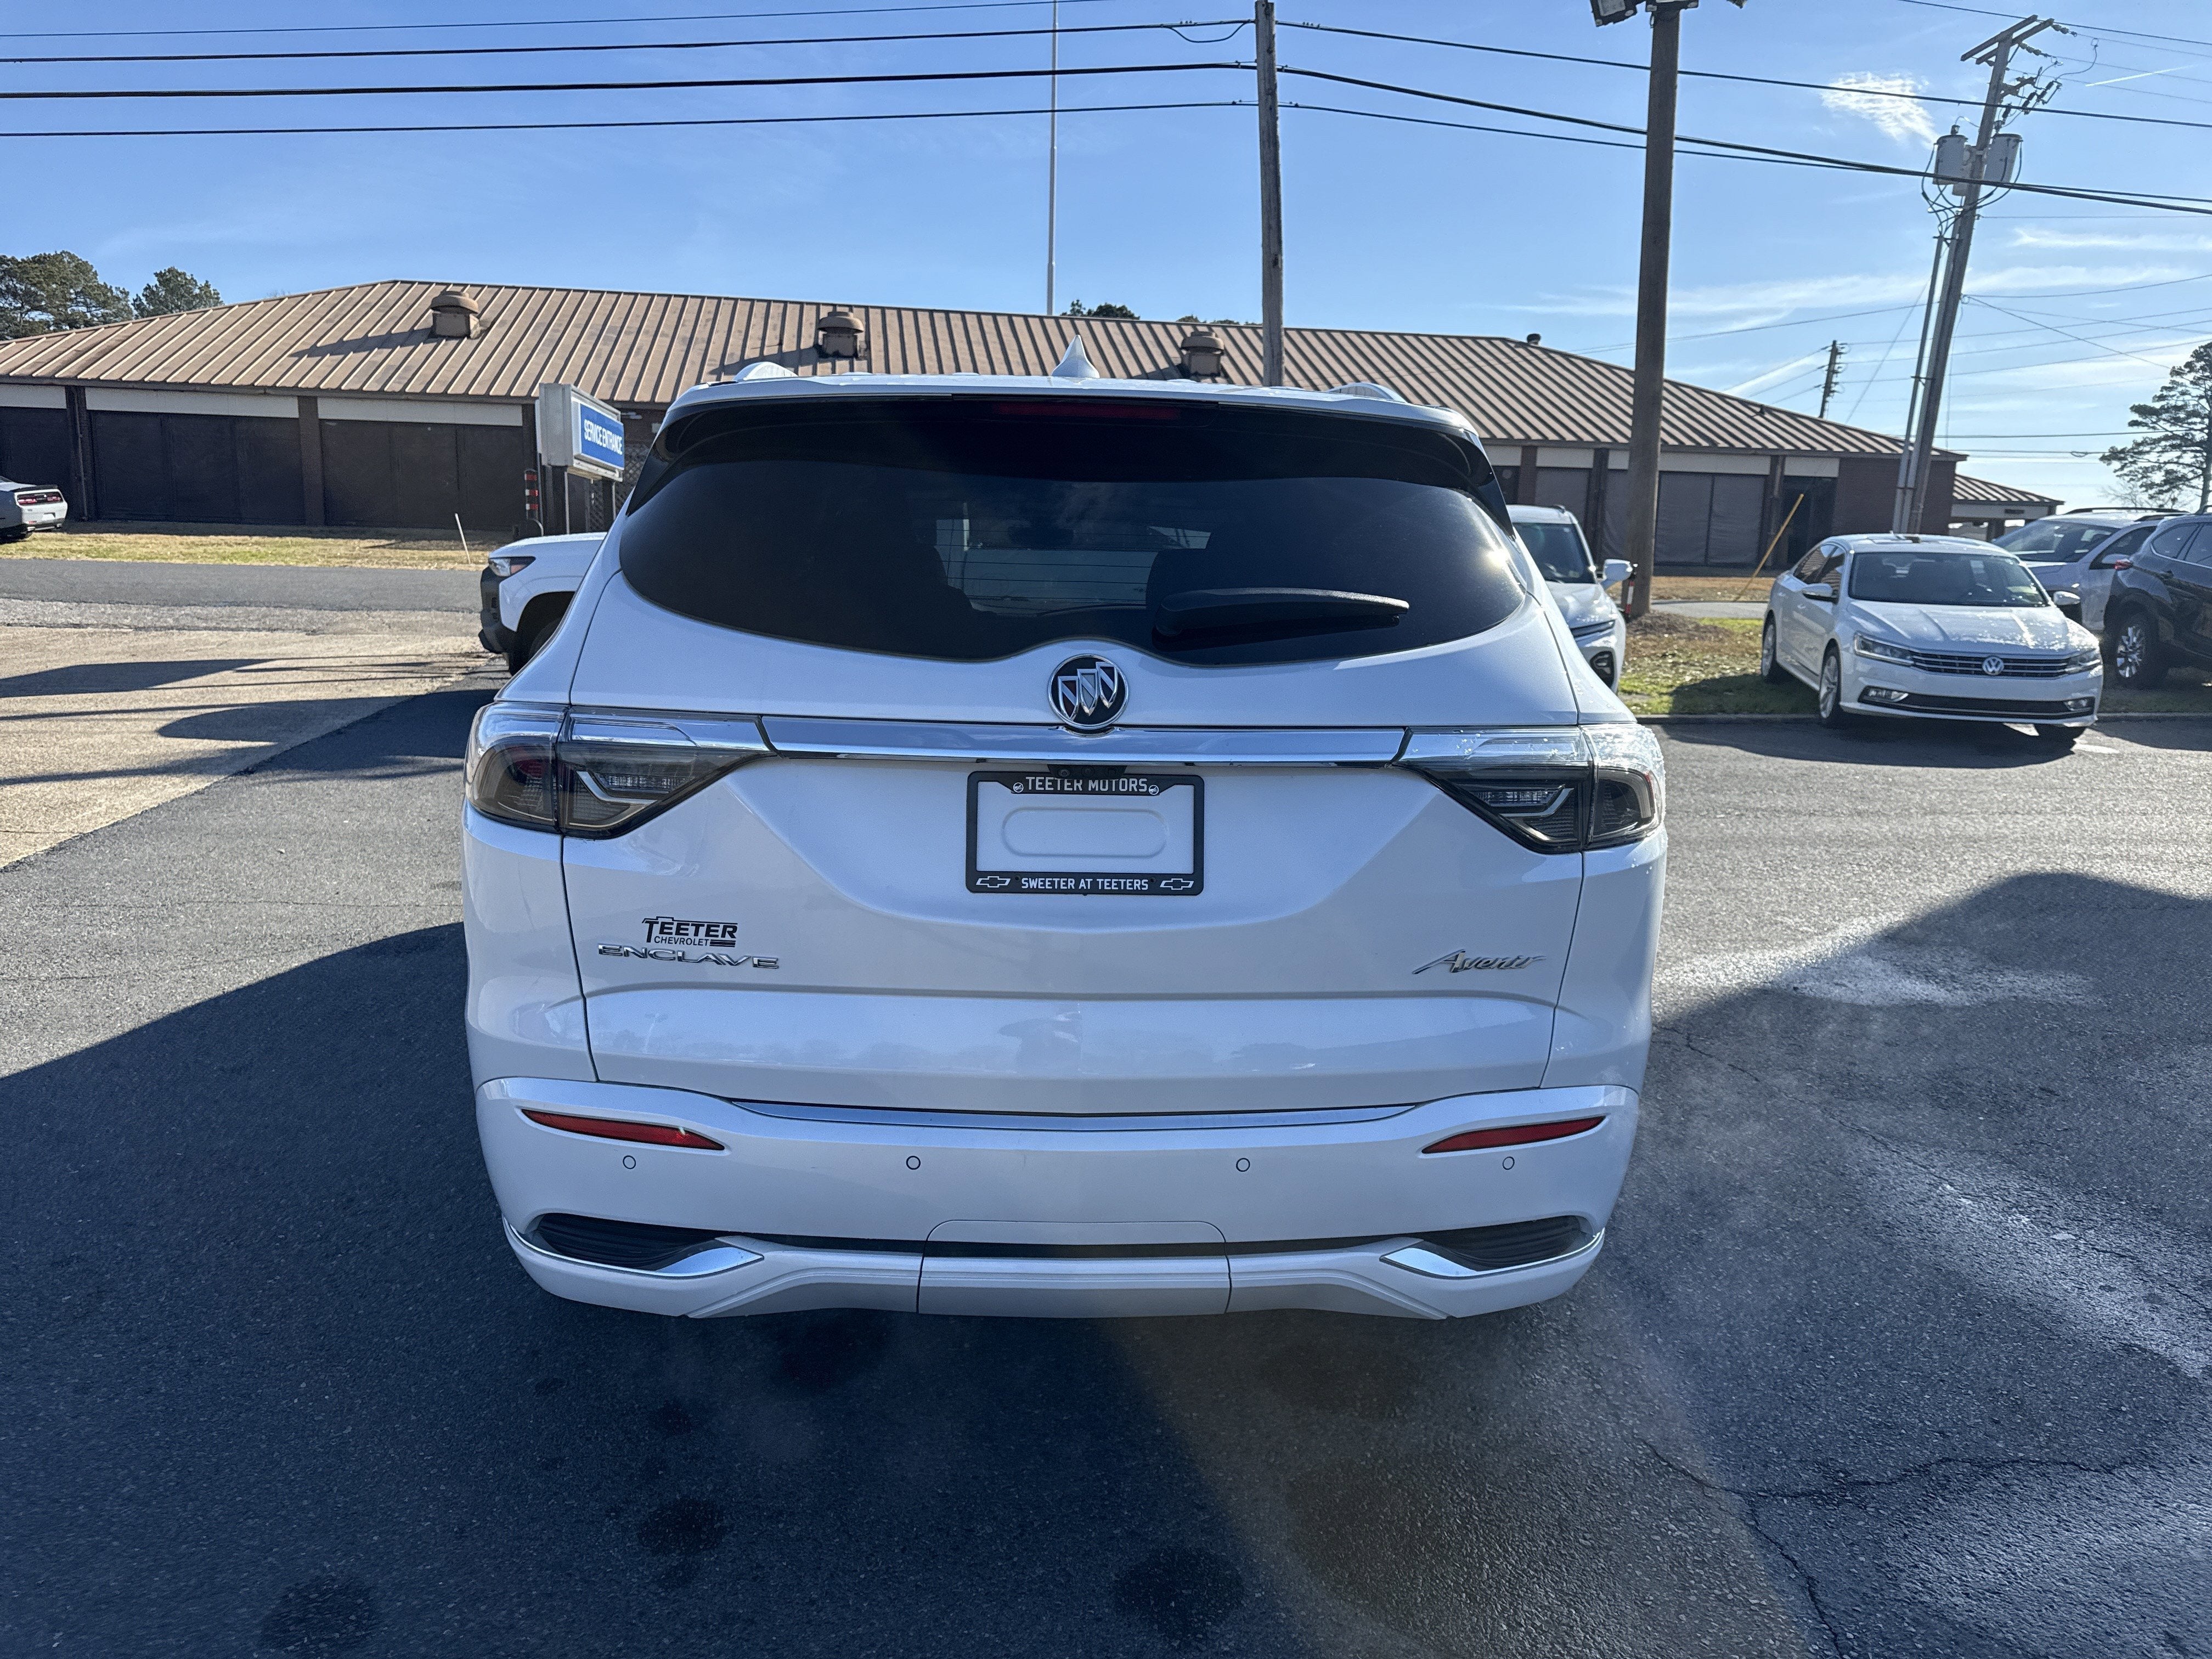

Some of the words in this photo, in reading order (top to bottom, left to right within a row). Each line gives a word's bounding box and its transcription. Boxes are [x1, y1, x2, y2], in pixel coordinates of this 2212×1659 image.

[584, 419, 602, 446] SERVICE
[602, 428, 623, 455] ENTRANCE
[1025, 776, 1083, 791] TEETER
[1088, 778, 1148, 792] MOTORS
[1021, 877, 1075, 889] SWEETER
[1079, 878, 1093, 889] AT
[1096, 878, 1149, 890] TEETERS
[642, 920, 738, 943] TEETER
[654, 935, 710, 947] CHEVROLET
[598, 943, 780, 969] ENCLAVE
[1412, 949, 1547, 974] Avenir
